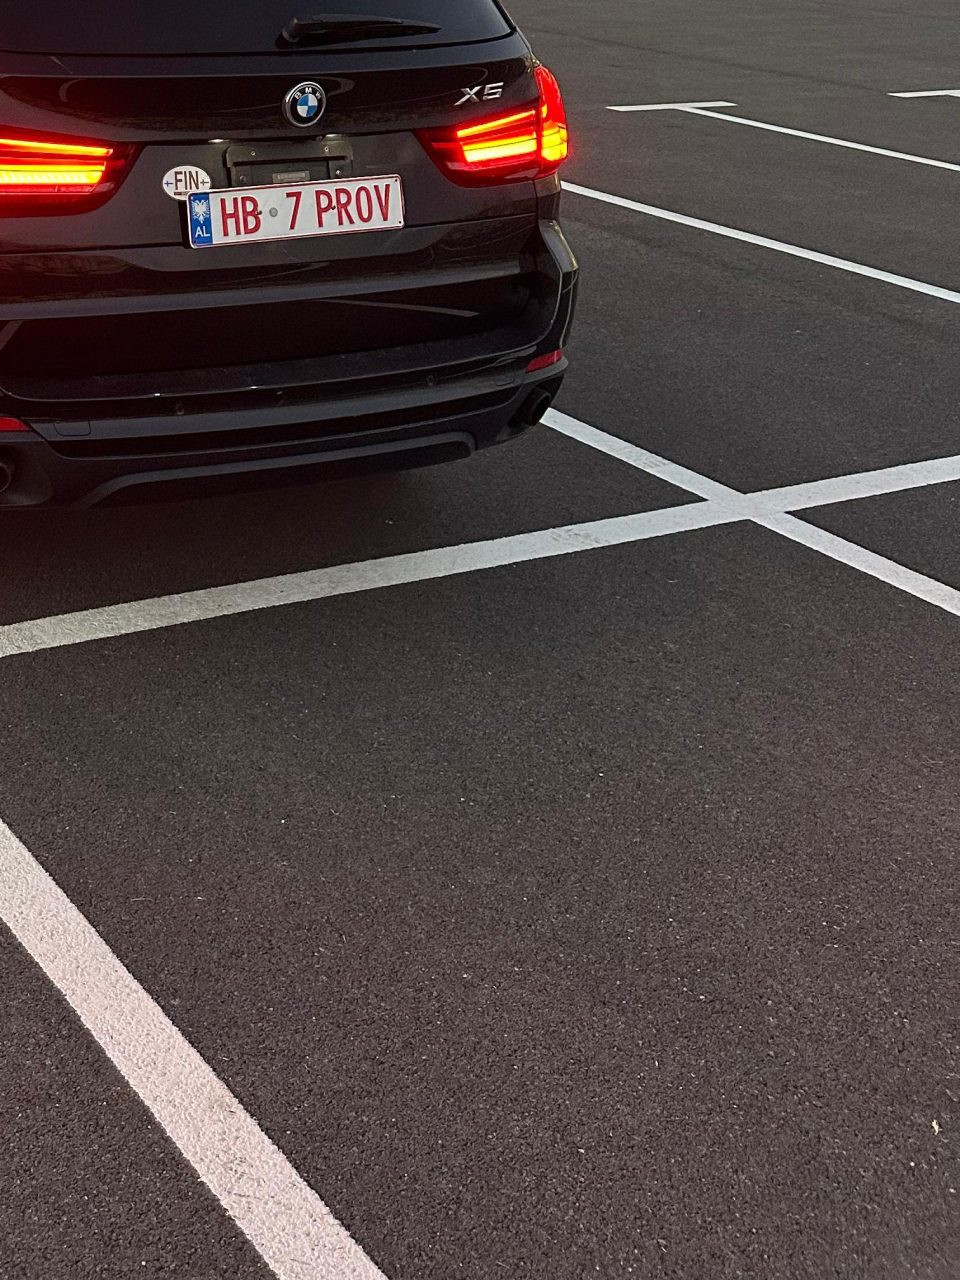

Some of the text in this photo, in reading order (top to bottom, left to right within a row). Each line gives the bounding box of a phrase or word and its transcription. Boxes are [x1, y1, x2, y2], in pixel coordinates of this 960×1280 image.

[453, 82, 504, 106] X5
[174, 170, 200, 191] FIN
[220, 183, 391, 237] HB 7 PROV
[195, 226, 211, 238] AL
